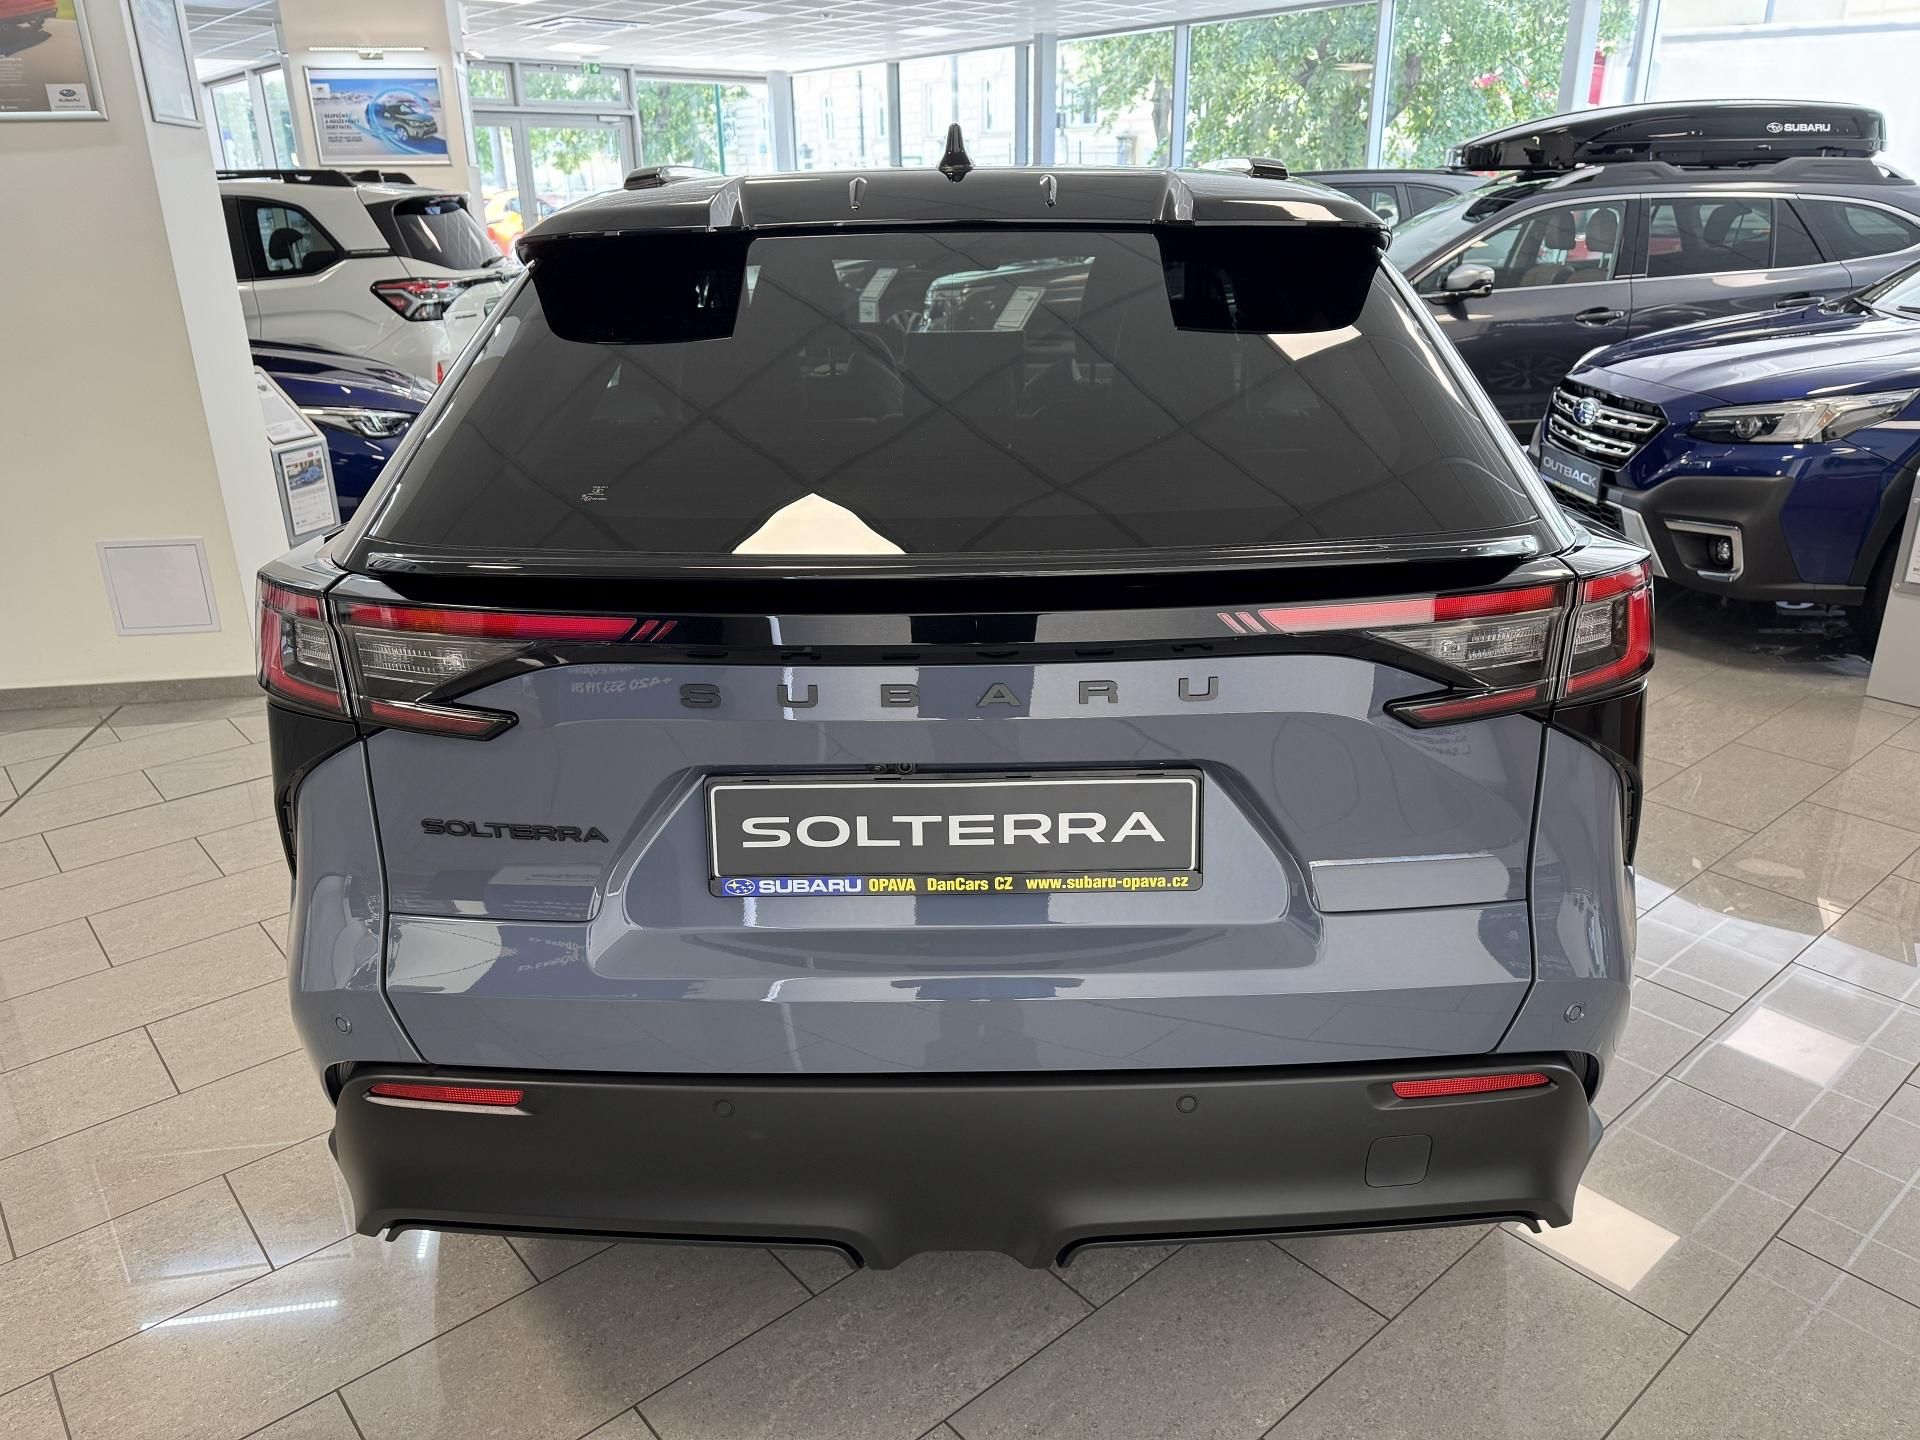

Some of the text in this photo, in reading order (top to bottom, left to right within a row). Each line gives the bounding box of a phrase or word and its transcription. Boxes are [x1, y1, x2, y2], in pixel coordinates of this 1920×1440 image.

[1783, 123, 1831, 132] SUBARU
[1543, 456, 1597, 488] OUTBACK
[679, 676, 1219, 709] SUBARU
[421, 818, 609, 843] SOLTERRA
[742, 811, 1166, 849] SOLTERRA
[758, 875, 1189, 893] SUBARU OPAVA DanCars CZ www.subaru-opava.cz
